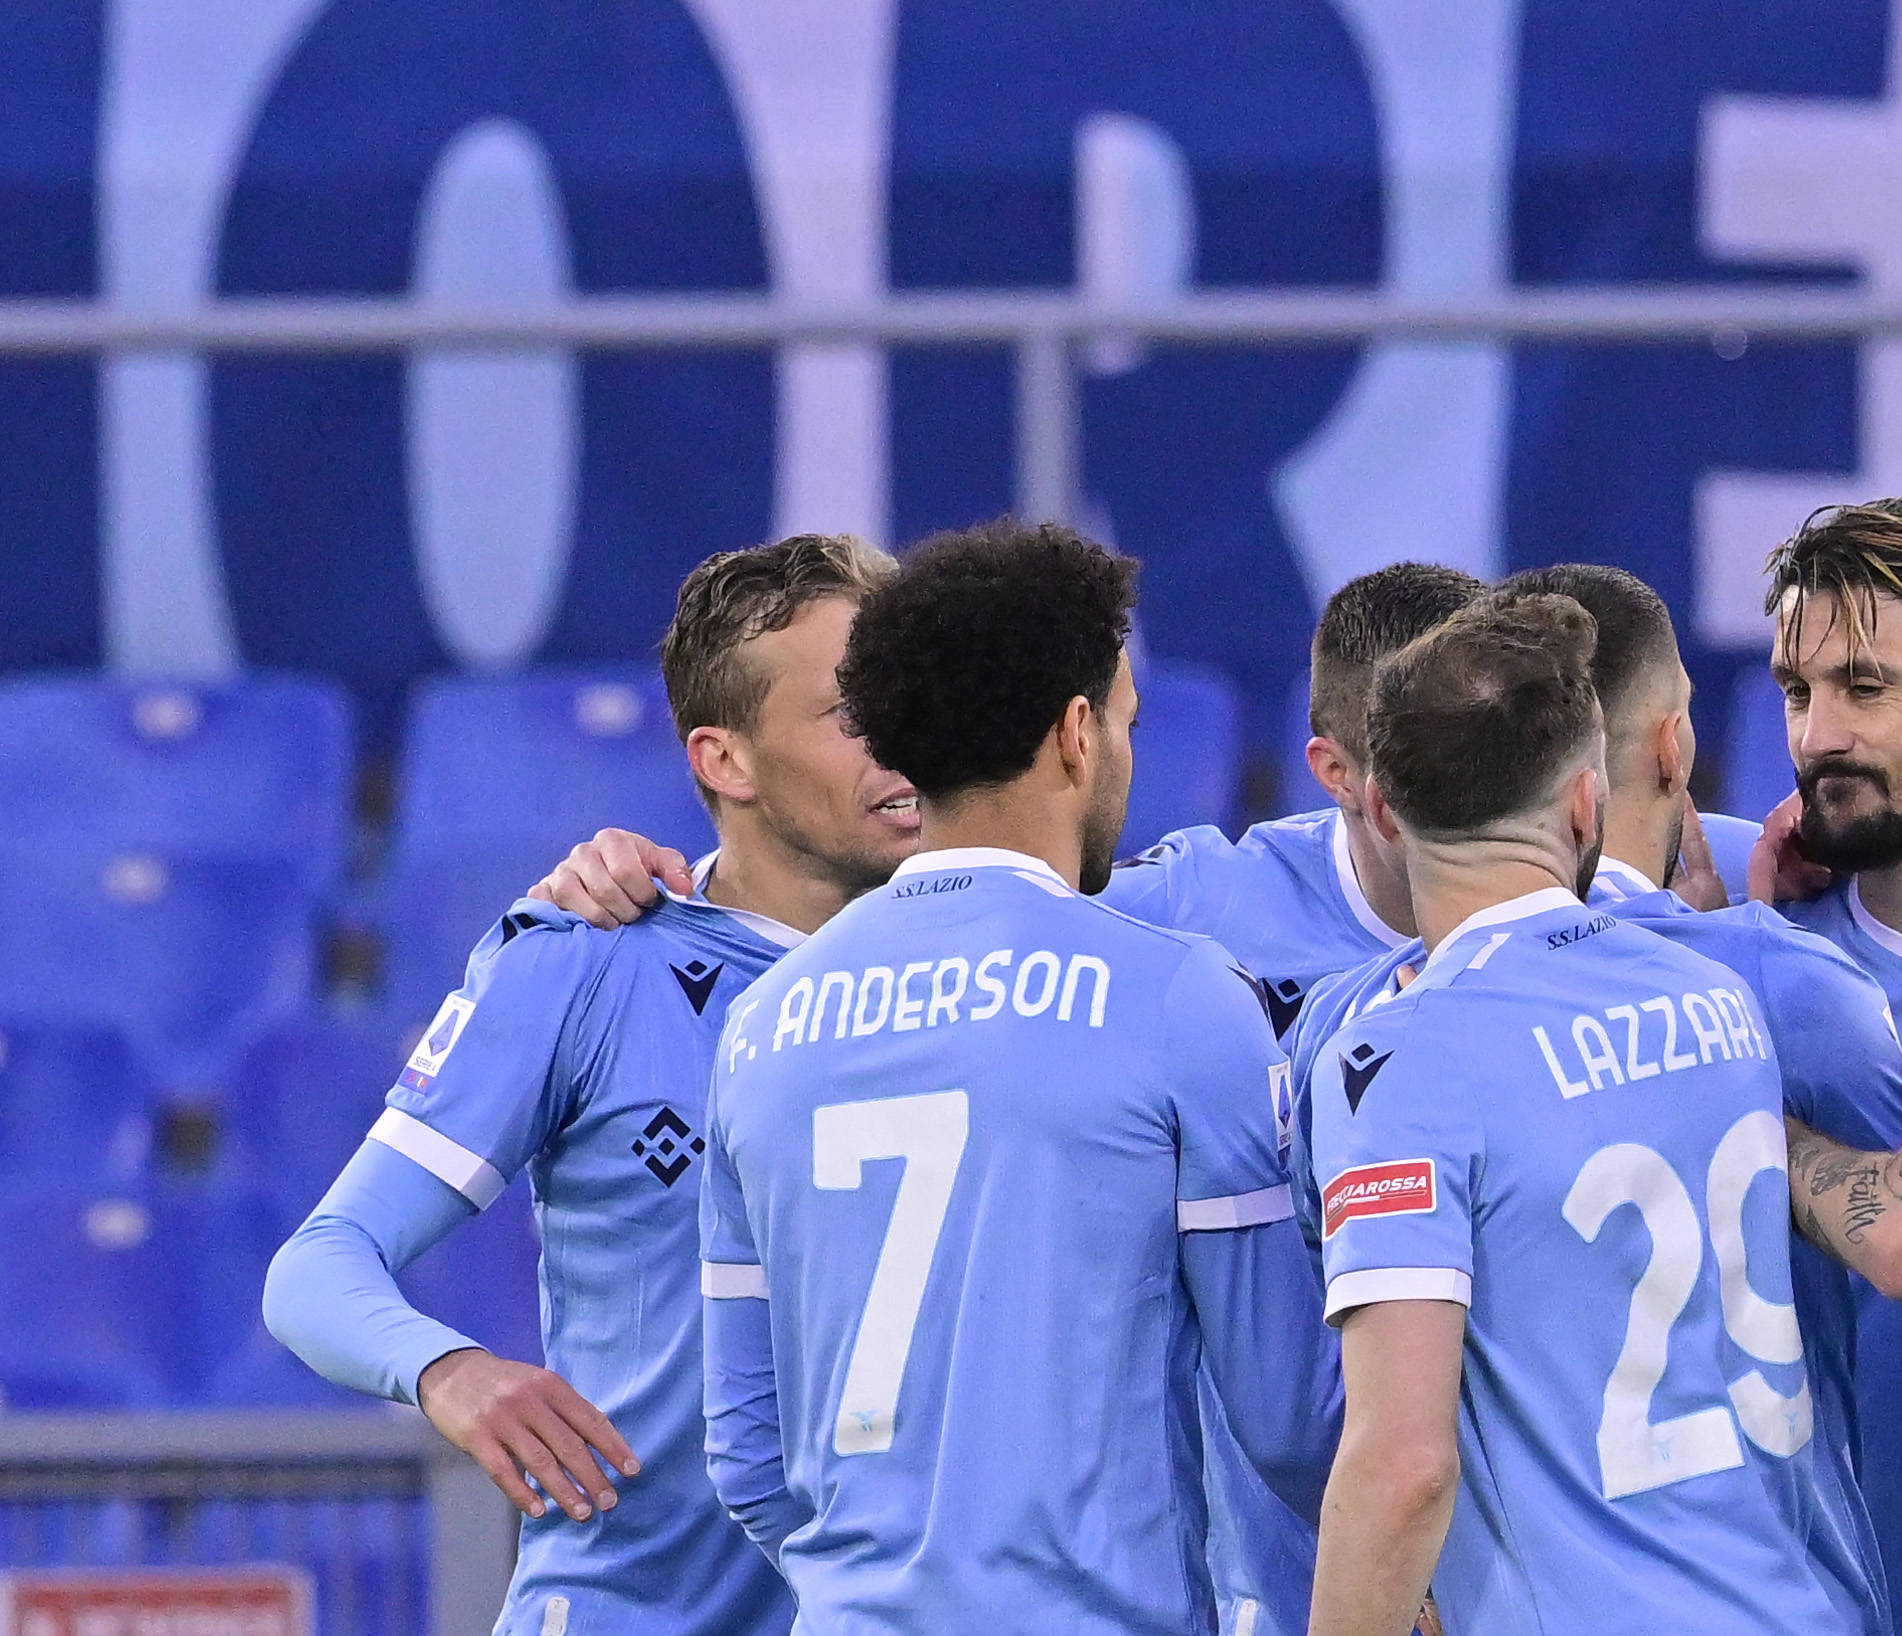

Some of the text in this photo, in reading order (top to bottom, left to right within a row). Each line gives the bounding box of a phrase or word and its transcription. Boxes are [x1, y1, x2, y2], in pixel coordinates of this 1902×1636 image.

[0, 0, 1900, 670] ORE
[772, 949, 1112, 1052] ANDERSON
[813, 1088, 969, 1457] 7
[1561, 1109, 1815, 1500] 29
